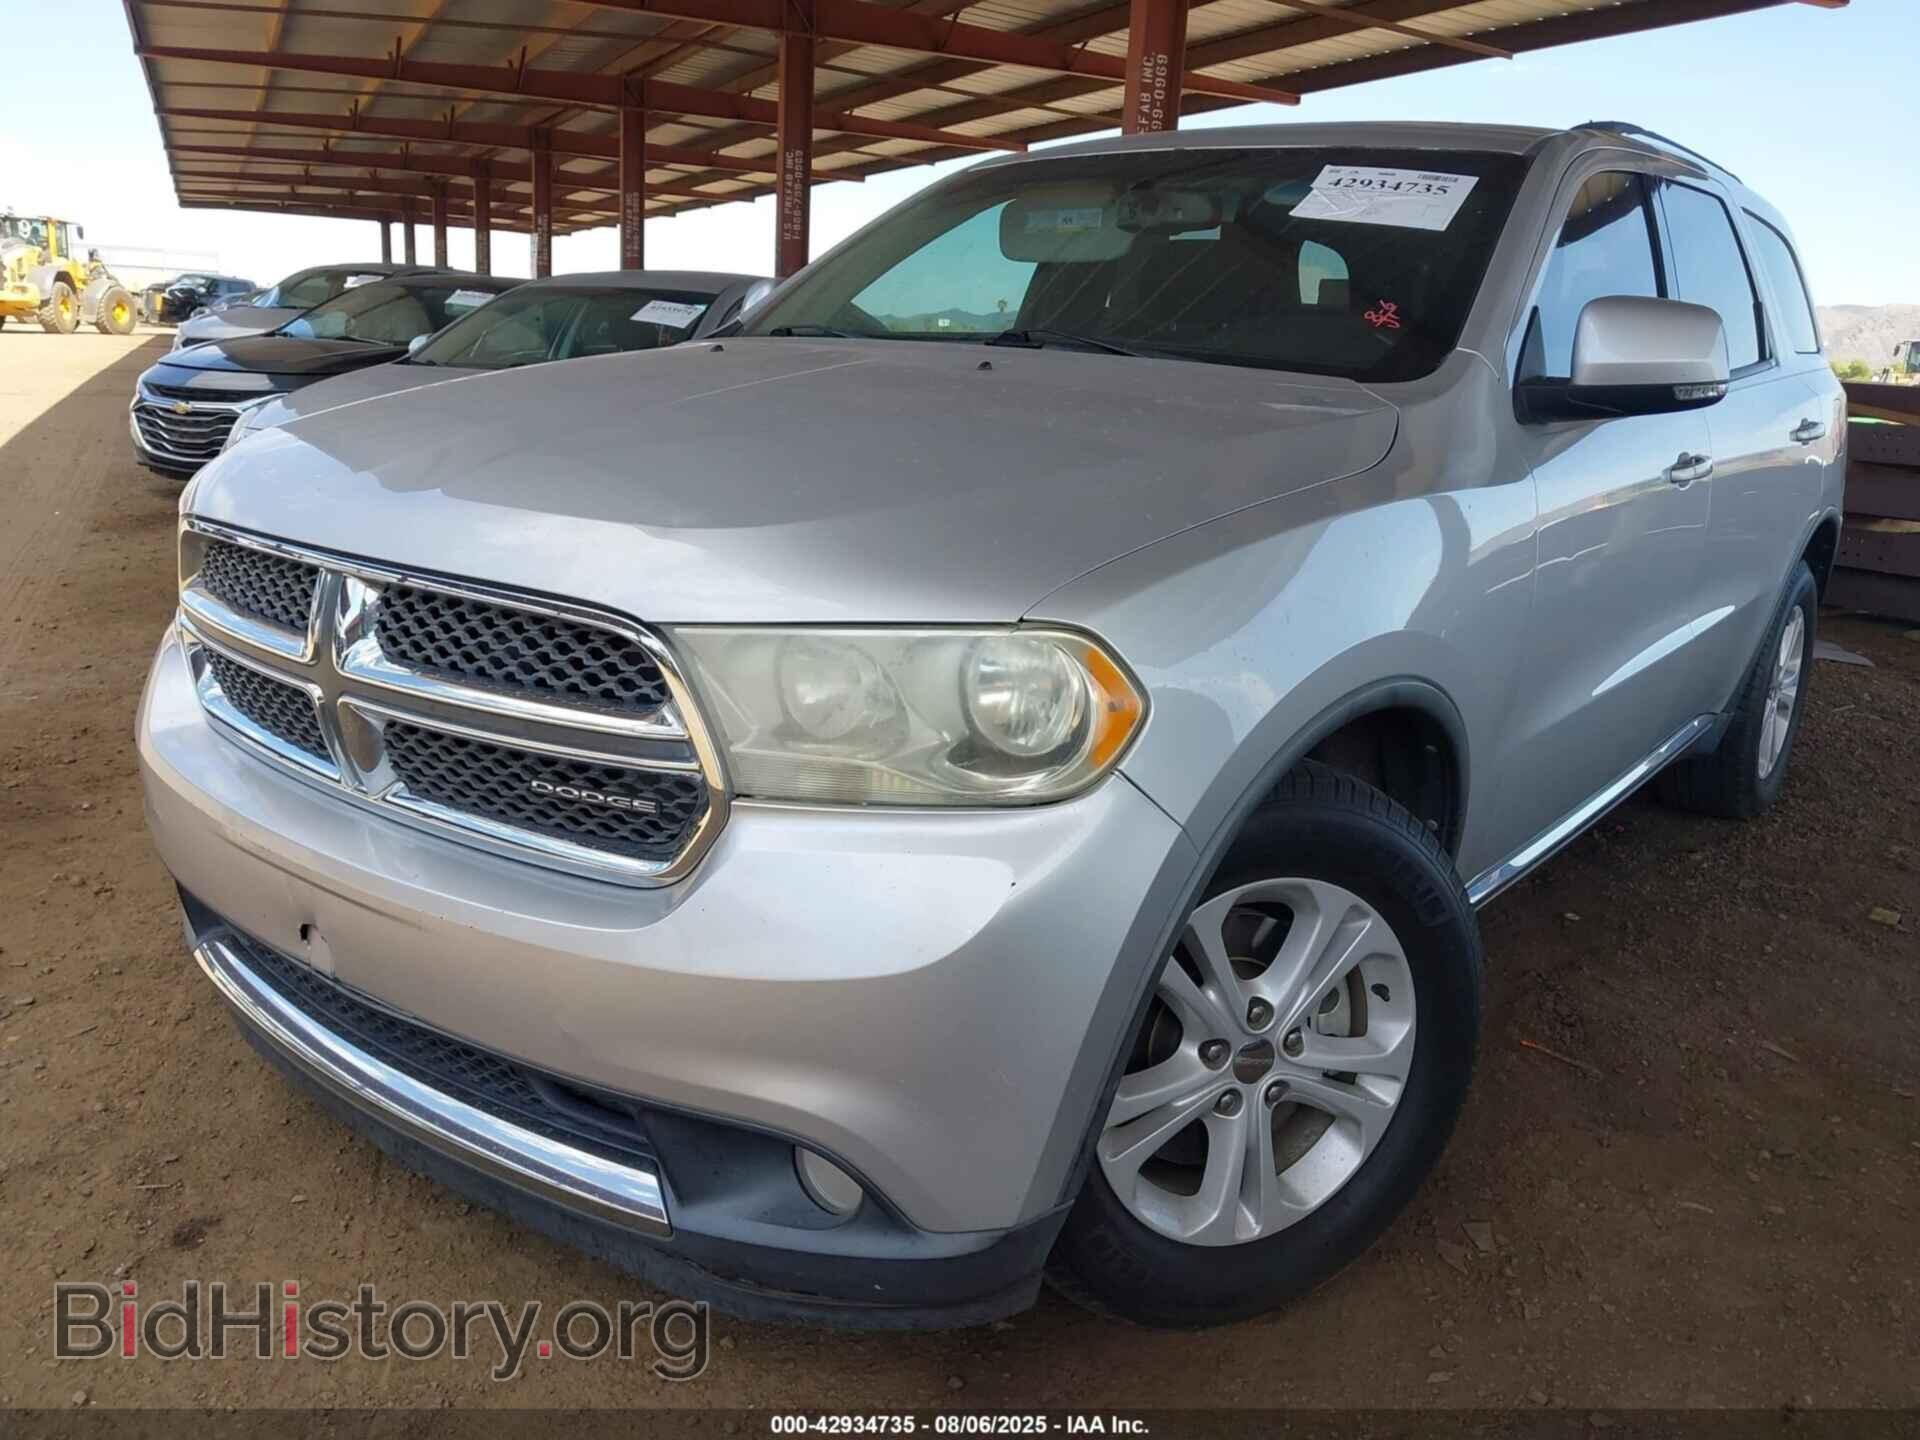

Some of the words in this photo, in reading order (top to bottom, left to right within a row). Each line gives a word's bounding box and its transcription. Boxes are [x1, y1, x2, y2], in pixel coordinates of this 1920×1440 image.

[1141, 52, 1156, 83] INC.
[1328, 177, 1450, 197] 42934735
[531, 780, 657, 814] DODGE
